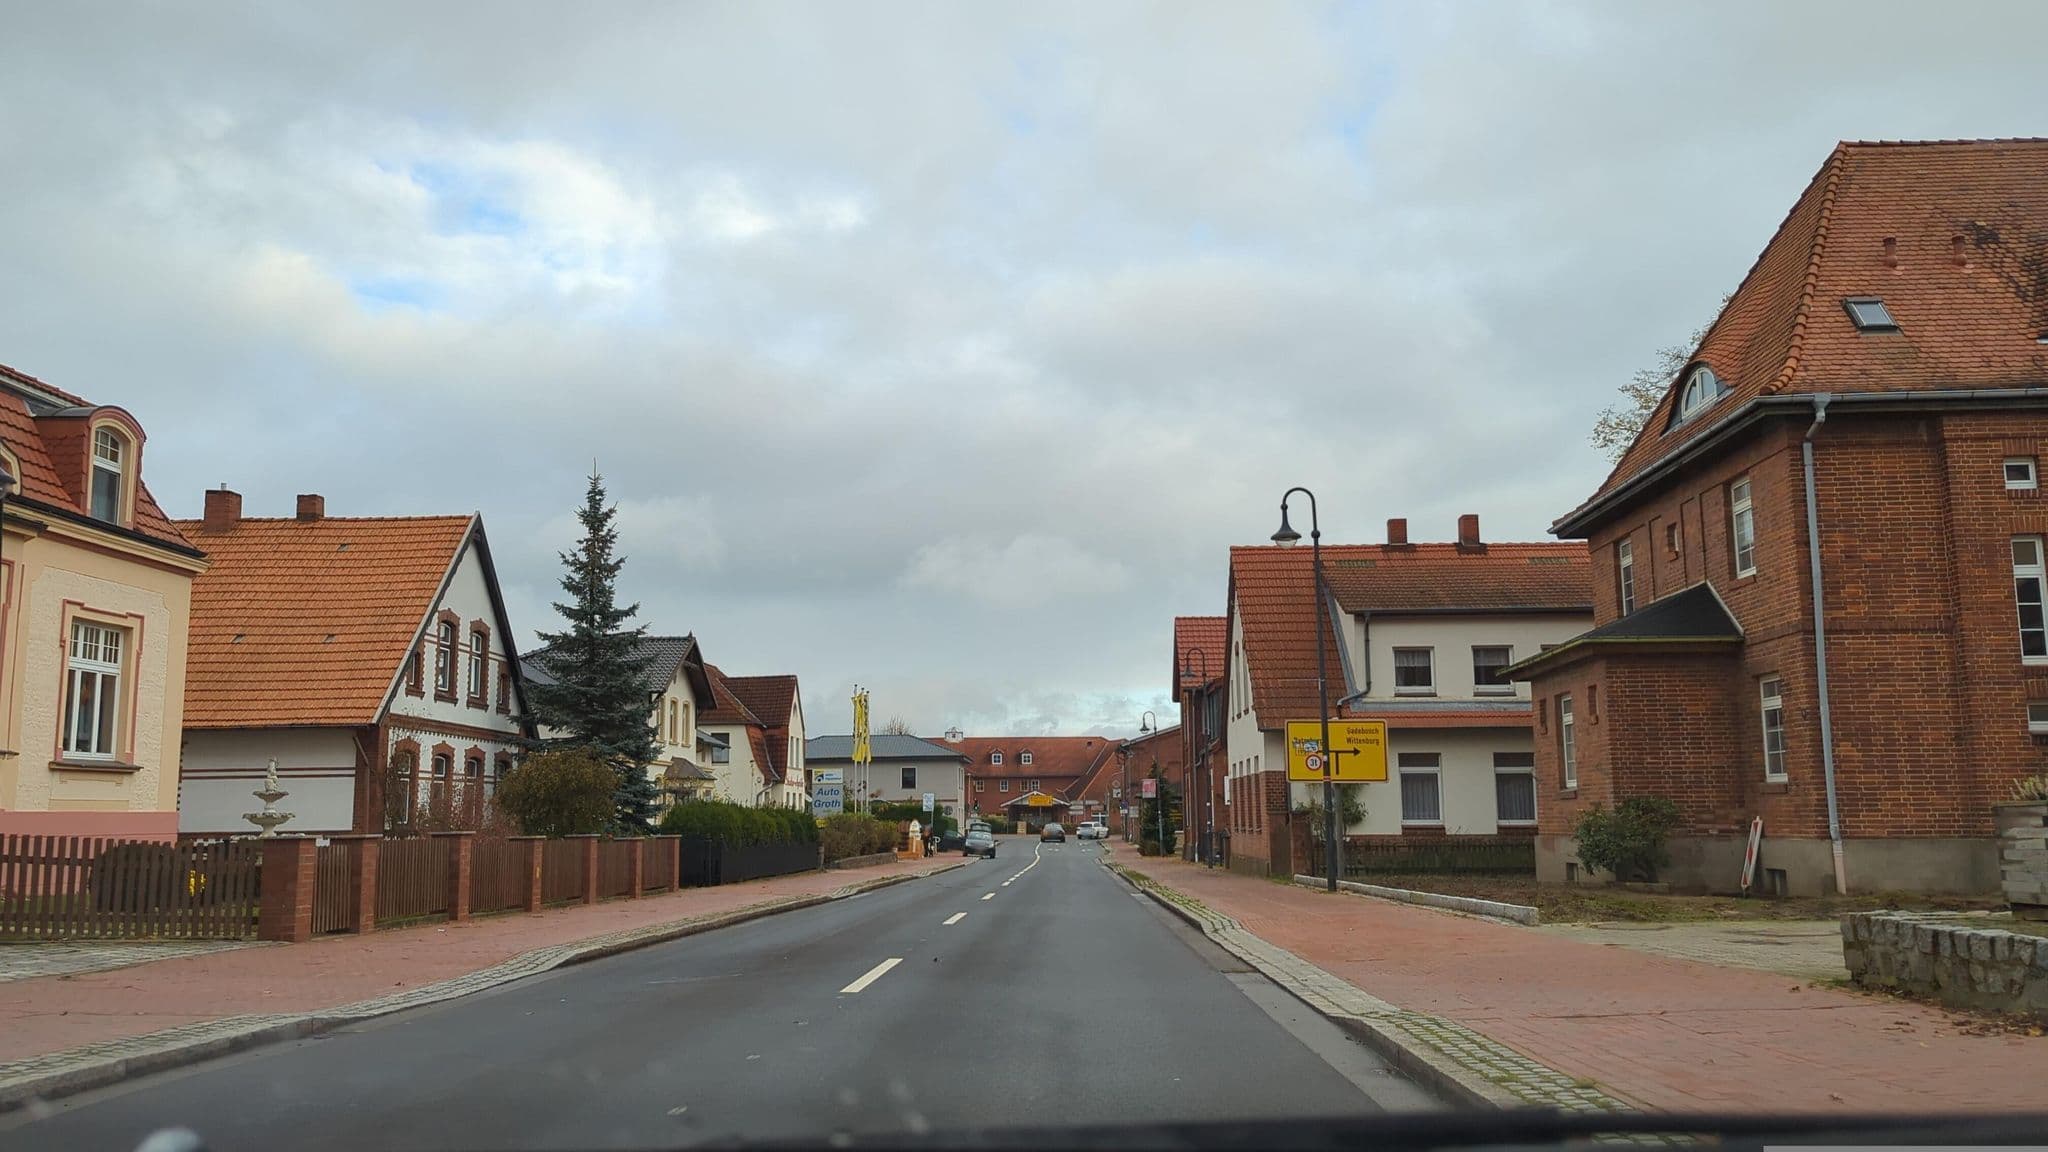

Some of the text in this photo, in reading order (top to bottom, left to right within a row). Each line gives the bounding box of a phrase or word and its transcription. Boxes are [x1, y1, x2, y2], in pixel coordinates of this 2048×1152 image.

[1346, 737, 1380, 746] Wittenburg
[816, 788, 840, 796] Auto
[813, 799, 841, 808] Groth
